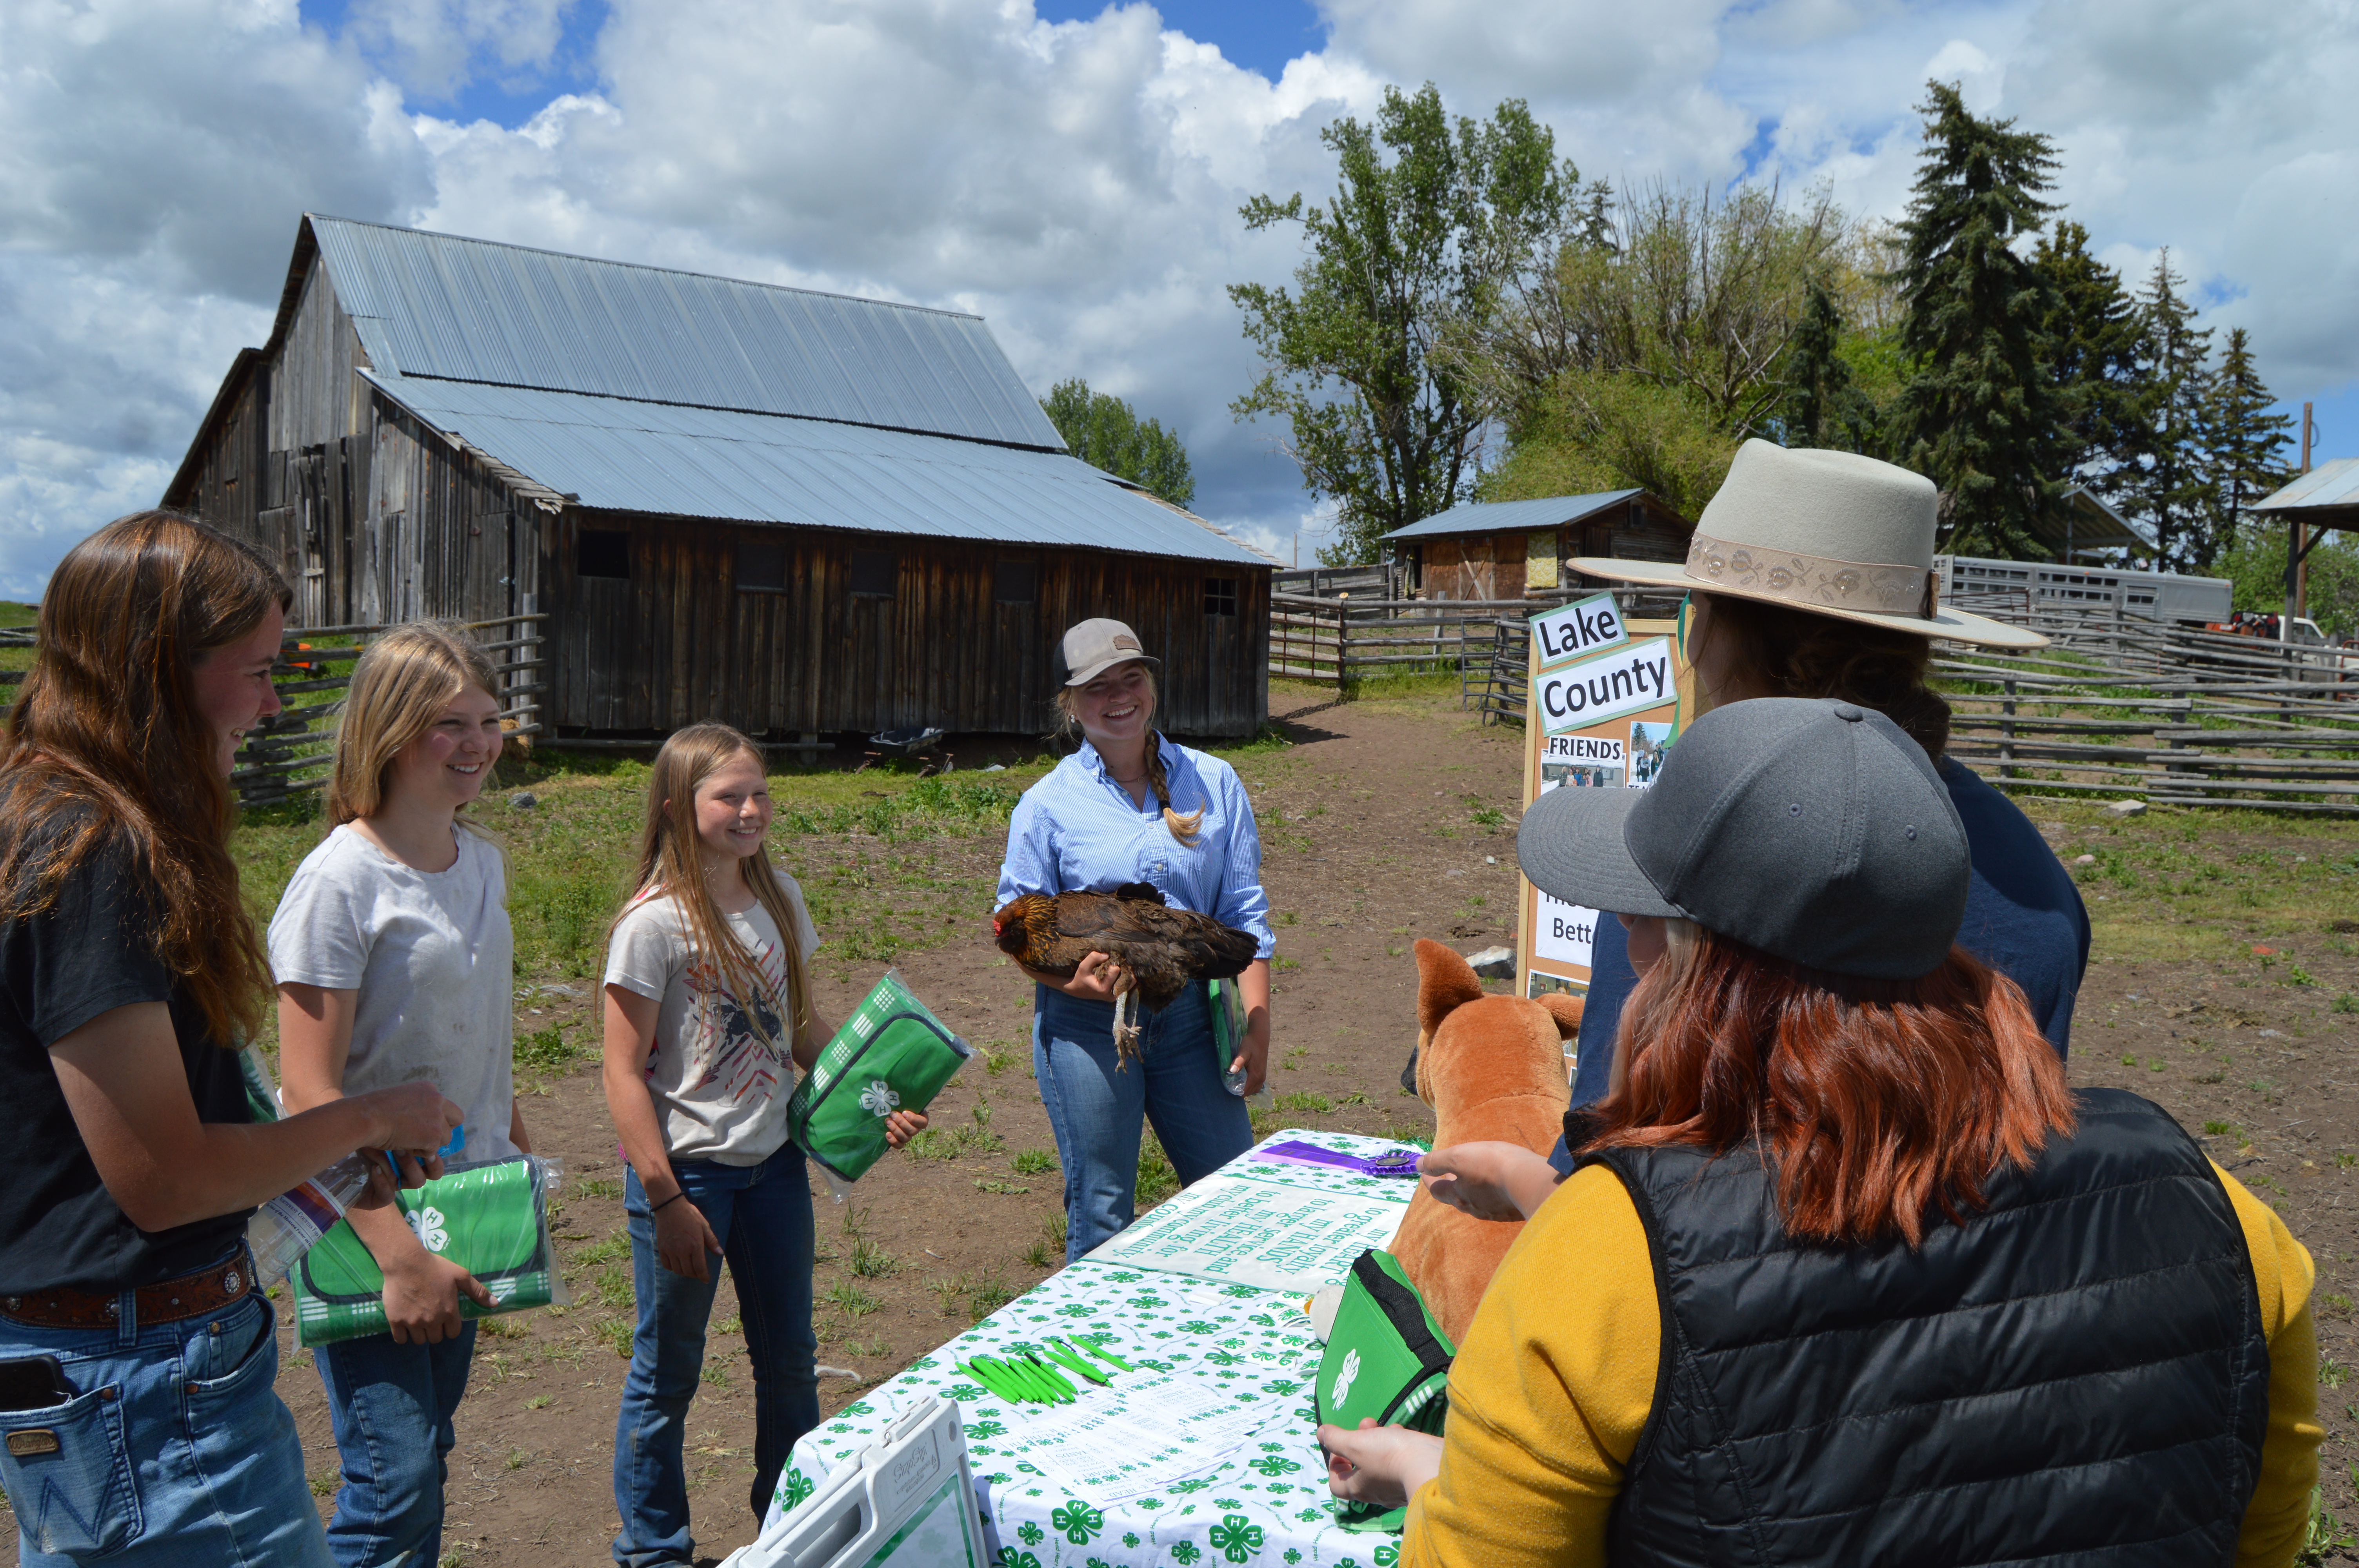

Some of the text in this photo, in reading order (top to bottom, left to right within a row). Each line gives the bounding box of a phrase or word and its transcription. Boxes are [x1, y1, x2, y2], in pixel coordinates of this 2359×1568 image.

[1539, 608, 1618, 657] Lake
[1545, 657, 1666, 717] County
[1549, 737, 1621, 760] FRIENDS
[1553, 917, 1592, 944] Bett
[1220, 1185, 1251, 1196] my
[1176, 1192, 1202, 1204] my
[1177, 1208, 1210, 1220] my
[1219, 1198, 1271, 1220] better
[298, 1212, 313, 1230] COUNTIES
[406, 1216, 417, 1228] H
[427, 1212, 438, 1224] H
[1276, 1205, 1327, 1227] larger
[283, 1215, 297, 1229] Montana
[296, 1228, 306, 1240] Farmer
[1193, 1209, 1277, 1256] my HEALTH
[1323, 1212, 1373, 1244] greater
[431, 1234, 442, 1245] H
[1256, 1218, 1334, 1263] my HANDS
[1155, 1245, 1189, 1257] for
[1319, 1229, 1390, 1274] my HEART
[1203, 1257, 1238, 1274] and
[1346, 1354, 1352, 1368] H
[1351, 1364, 1358, 1376] H
[1122, 1375, 1155, 1387] HEALTH
[1335, 1379, 1341, 1391] H
[1157, 1390, 1185, 1399] HANDS
[1340, 1388, 1346, 1401] H
[1227, 1418, 1251, 1426] HEAD
[1222, 1430, 1244, 1439] HEAD
[11, 1436, 54, 1452] Wrangler
[1215, 1440, 1237, 1450] HEAD
[816, 1453, 824, 1468] Hands
[790, 1474, 798, 1484] H
[1082, 1468, 1116, 1478] HEART
[803, 1484, 811, 1493] H
[1109, 1488, 1138, 1497] HEAD
[783, 1494, 792, 1505] H
[998, 1493, 1007, 1508] Heart
[1056, 1515, 1066, 1524] H
[1088, 1514, 1098, 1523] H
[1150, 1516, 1161, 1529] Heart
[1231, 1518, 1240, 1526] H
[1074, 1532, 1081, 1541] H
[1214, 1533, 1224, 1542] H
[1248, 1531, 1258, 1541] H
[1312, 1530, 1324, 1544] Heart
[1004, 1550, 1014, 1560] H
[1232, 1548, 1240, 1559] H
[1024, 1558, 1035, 1568] H
